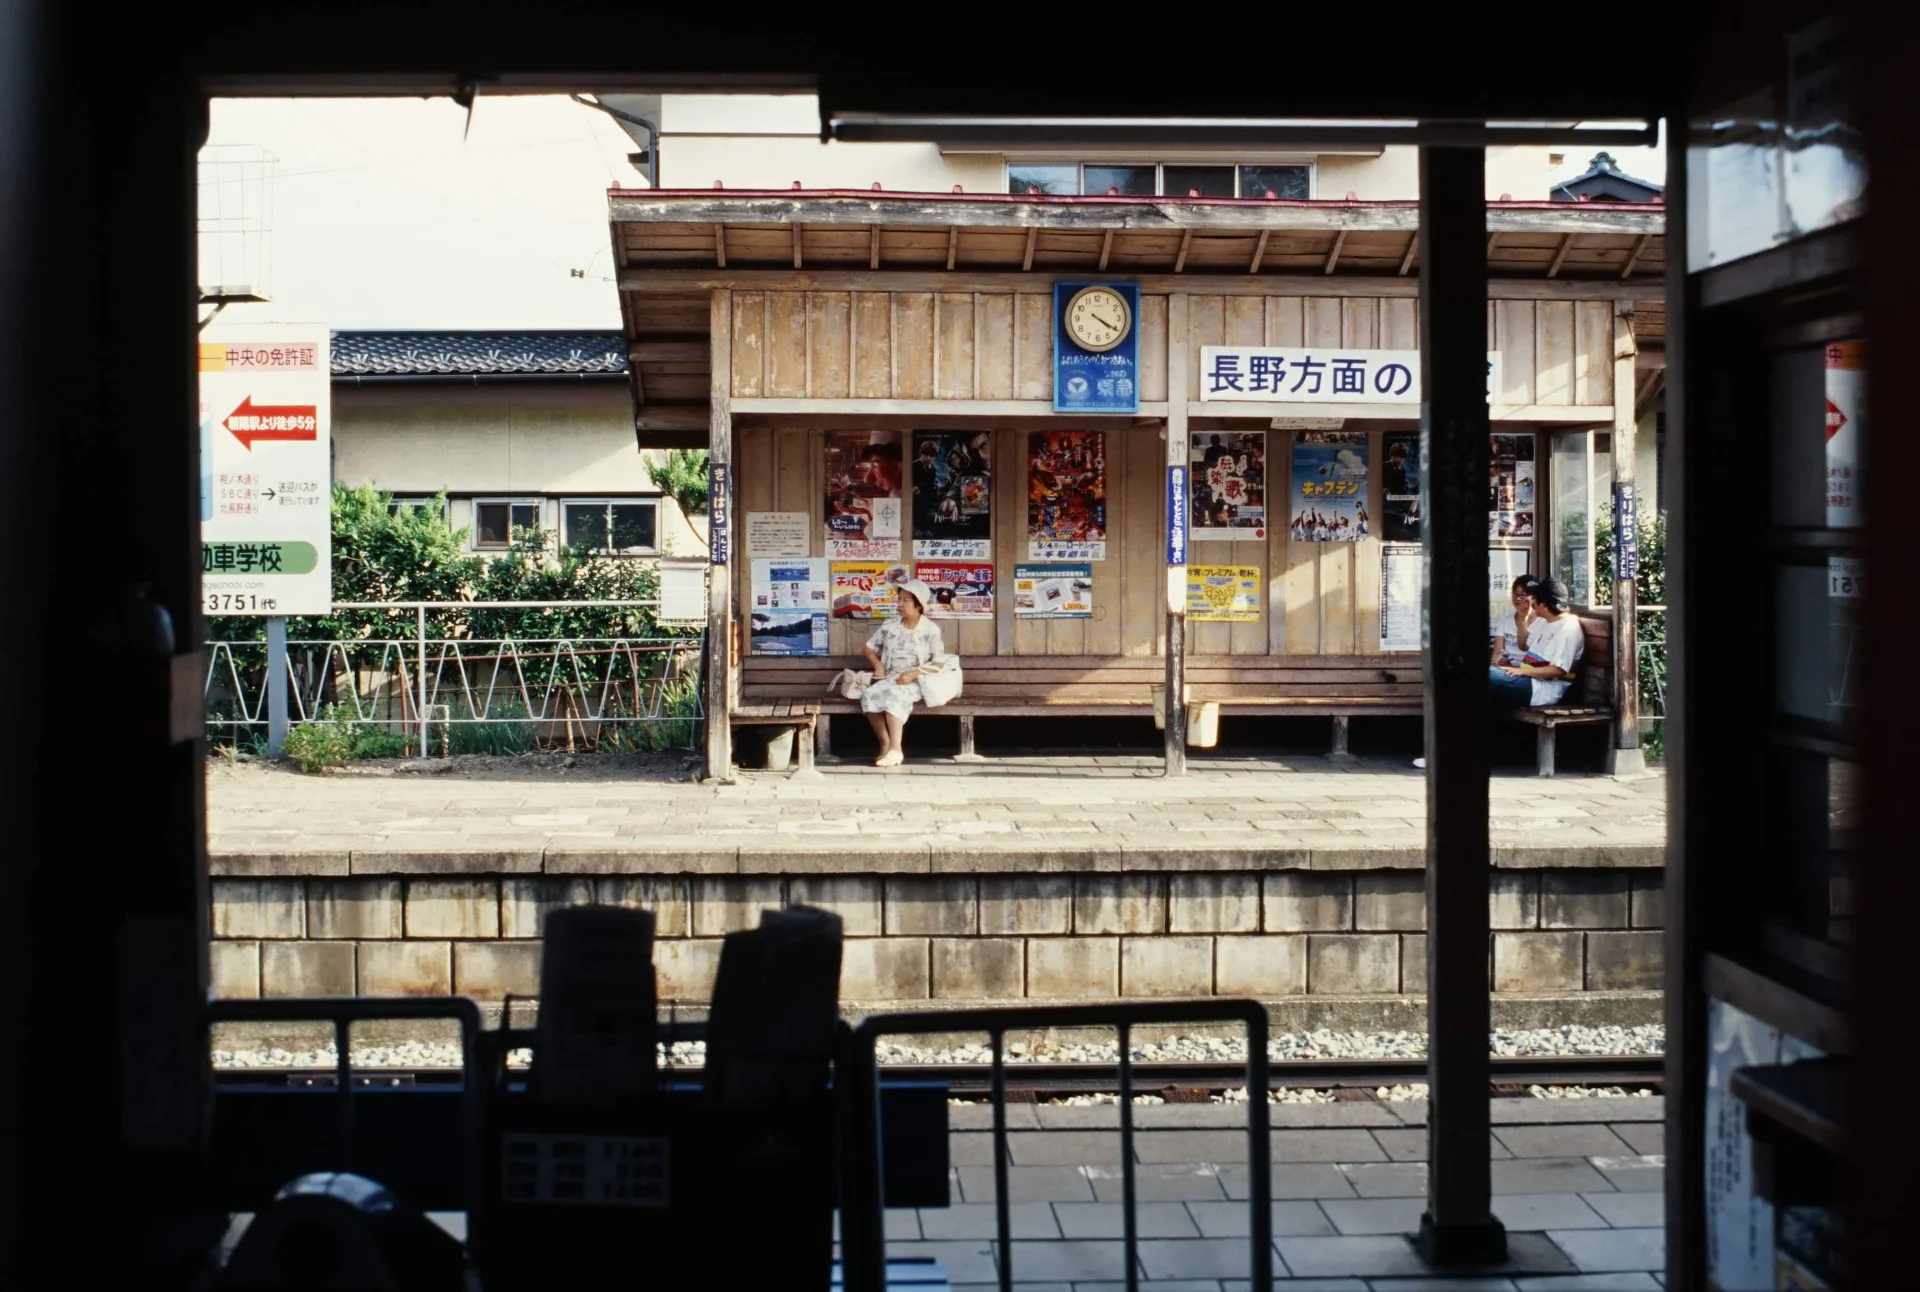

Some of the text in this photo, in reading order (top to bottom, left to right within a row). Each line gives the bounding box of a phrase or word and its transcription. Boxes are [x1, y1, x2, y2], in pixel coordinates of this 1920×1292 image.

[1094, 295, 1101, 303] 12
[1078, 305, 1085, 313] 10
[1074, 315, 1080, 323] 9
[1078, 325, 1084, 333] 8
[1105, 332, 1111, 340] 5
[225, 348, 314, 366] 中央の免許証
[1207, 355, 1494, 396] 長野方面の
[278, 481, 319, 493] 送迎バスが
[713, 467, 726, 524] きりはら
[220, 503, 259, 514] 北長野通り
[1622, 486, 1633, 541] きりはら
[863, 540, 898, 548] ロードショー
[1066, 540, 1100, 549] ロードショー
